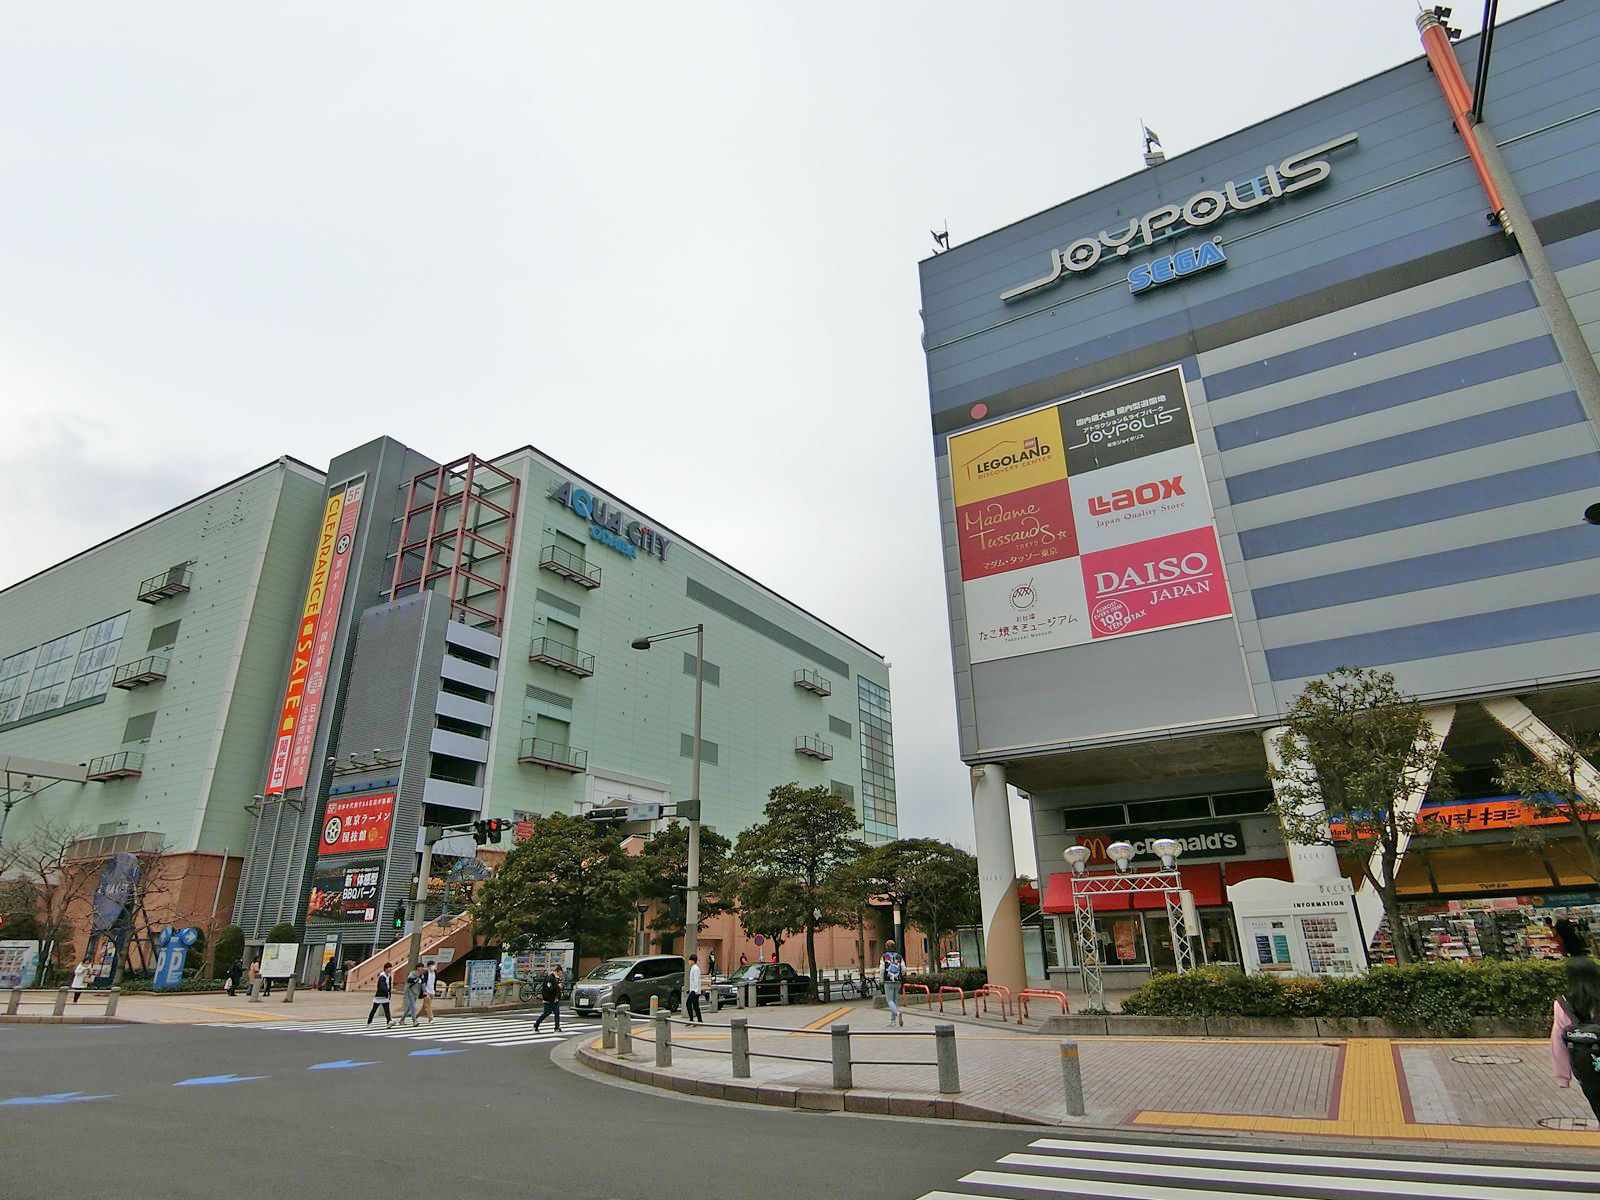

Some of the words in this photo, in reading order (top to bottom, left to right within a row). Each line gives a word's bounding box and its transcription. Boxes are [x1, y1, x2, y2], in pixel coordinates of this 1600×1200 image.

[1000, 131, 1358, 301] JOYPOLIS
[1127, 239, 1226, 294] SEGA
[1069, 407, 1181, 450] JOYPOLIS
[977, 437, 1051, 473] LEGOLAND
[978, 464, 1018, 479] DISCOVERY
[1022, 455, 1052, 467] CENTER
[347, 487, 361, 501] 5F
[550, 481, 624, 536] AQUA
[964, 503, 1040, 531] Madame
[1096, 517, 1121, 529] Japan
[1124, 509, 1157, 521] Quality
[1160, 502, 1185, 512] Store
[969, 516, 1056, 550] Tussauds
[1016, 540, 1039, 550] TOKYO
[307, 499, 341, 614] CLEARANCE
[1094, 552, 1208, 594] DAISO
[1150, 580, 1211, 605] JAPAN
[979, 614, 1078, 641] たこ焼きミュージアム
[1100, 611, 1123, 627] 100
[1107, 620, 1124, 631] YEN
[1130, 609, 1147, 621] TAX
[285, 641, 312, 710] SALE
[345, 812, 391, 827] 東京ラーメン
[1293, 900, 1345, 909] INFORMATION
